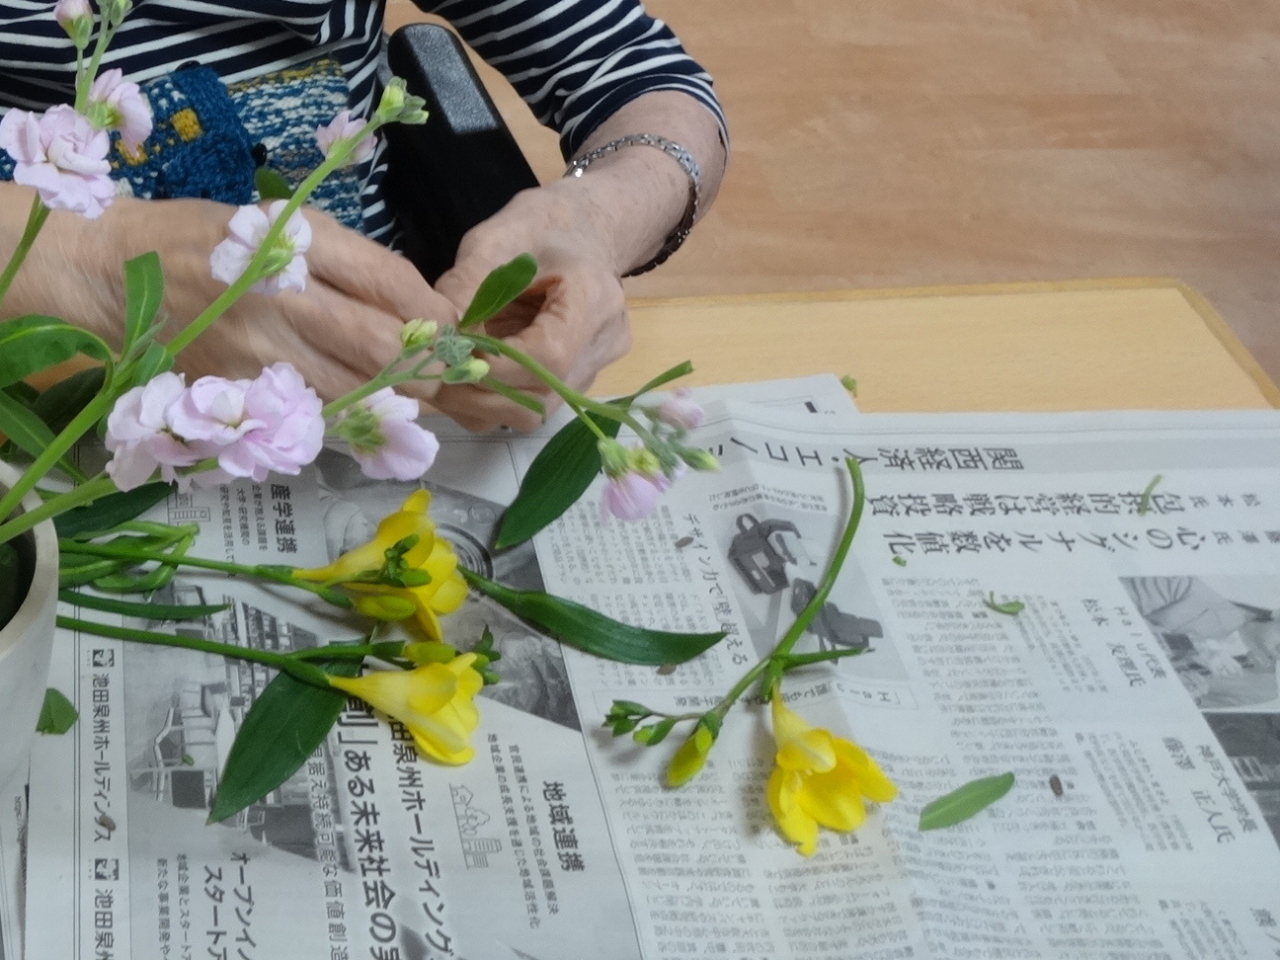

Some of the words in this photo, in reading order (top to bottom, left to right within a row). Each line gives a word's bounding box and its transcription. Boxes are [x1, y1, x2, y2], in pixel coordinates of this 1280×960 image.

[271, 483, 297, 554] 産学連携
[881, 526, 1206, 557] 心のシグナルを数値化
[390, 716, 453, 960] 田泉州ホールディング
[487, 732, 542, 930] 地域企業の成長支援を通じた地域活性化
[507, 743, 560, 916] 官民連携による地域の社会課題解決
[541, 780, 585, 873] 地域連携
[156, 858, 173, 960] 新たな事業開発や
